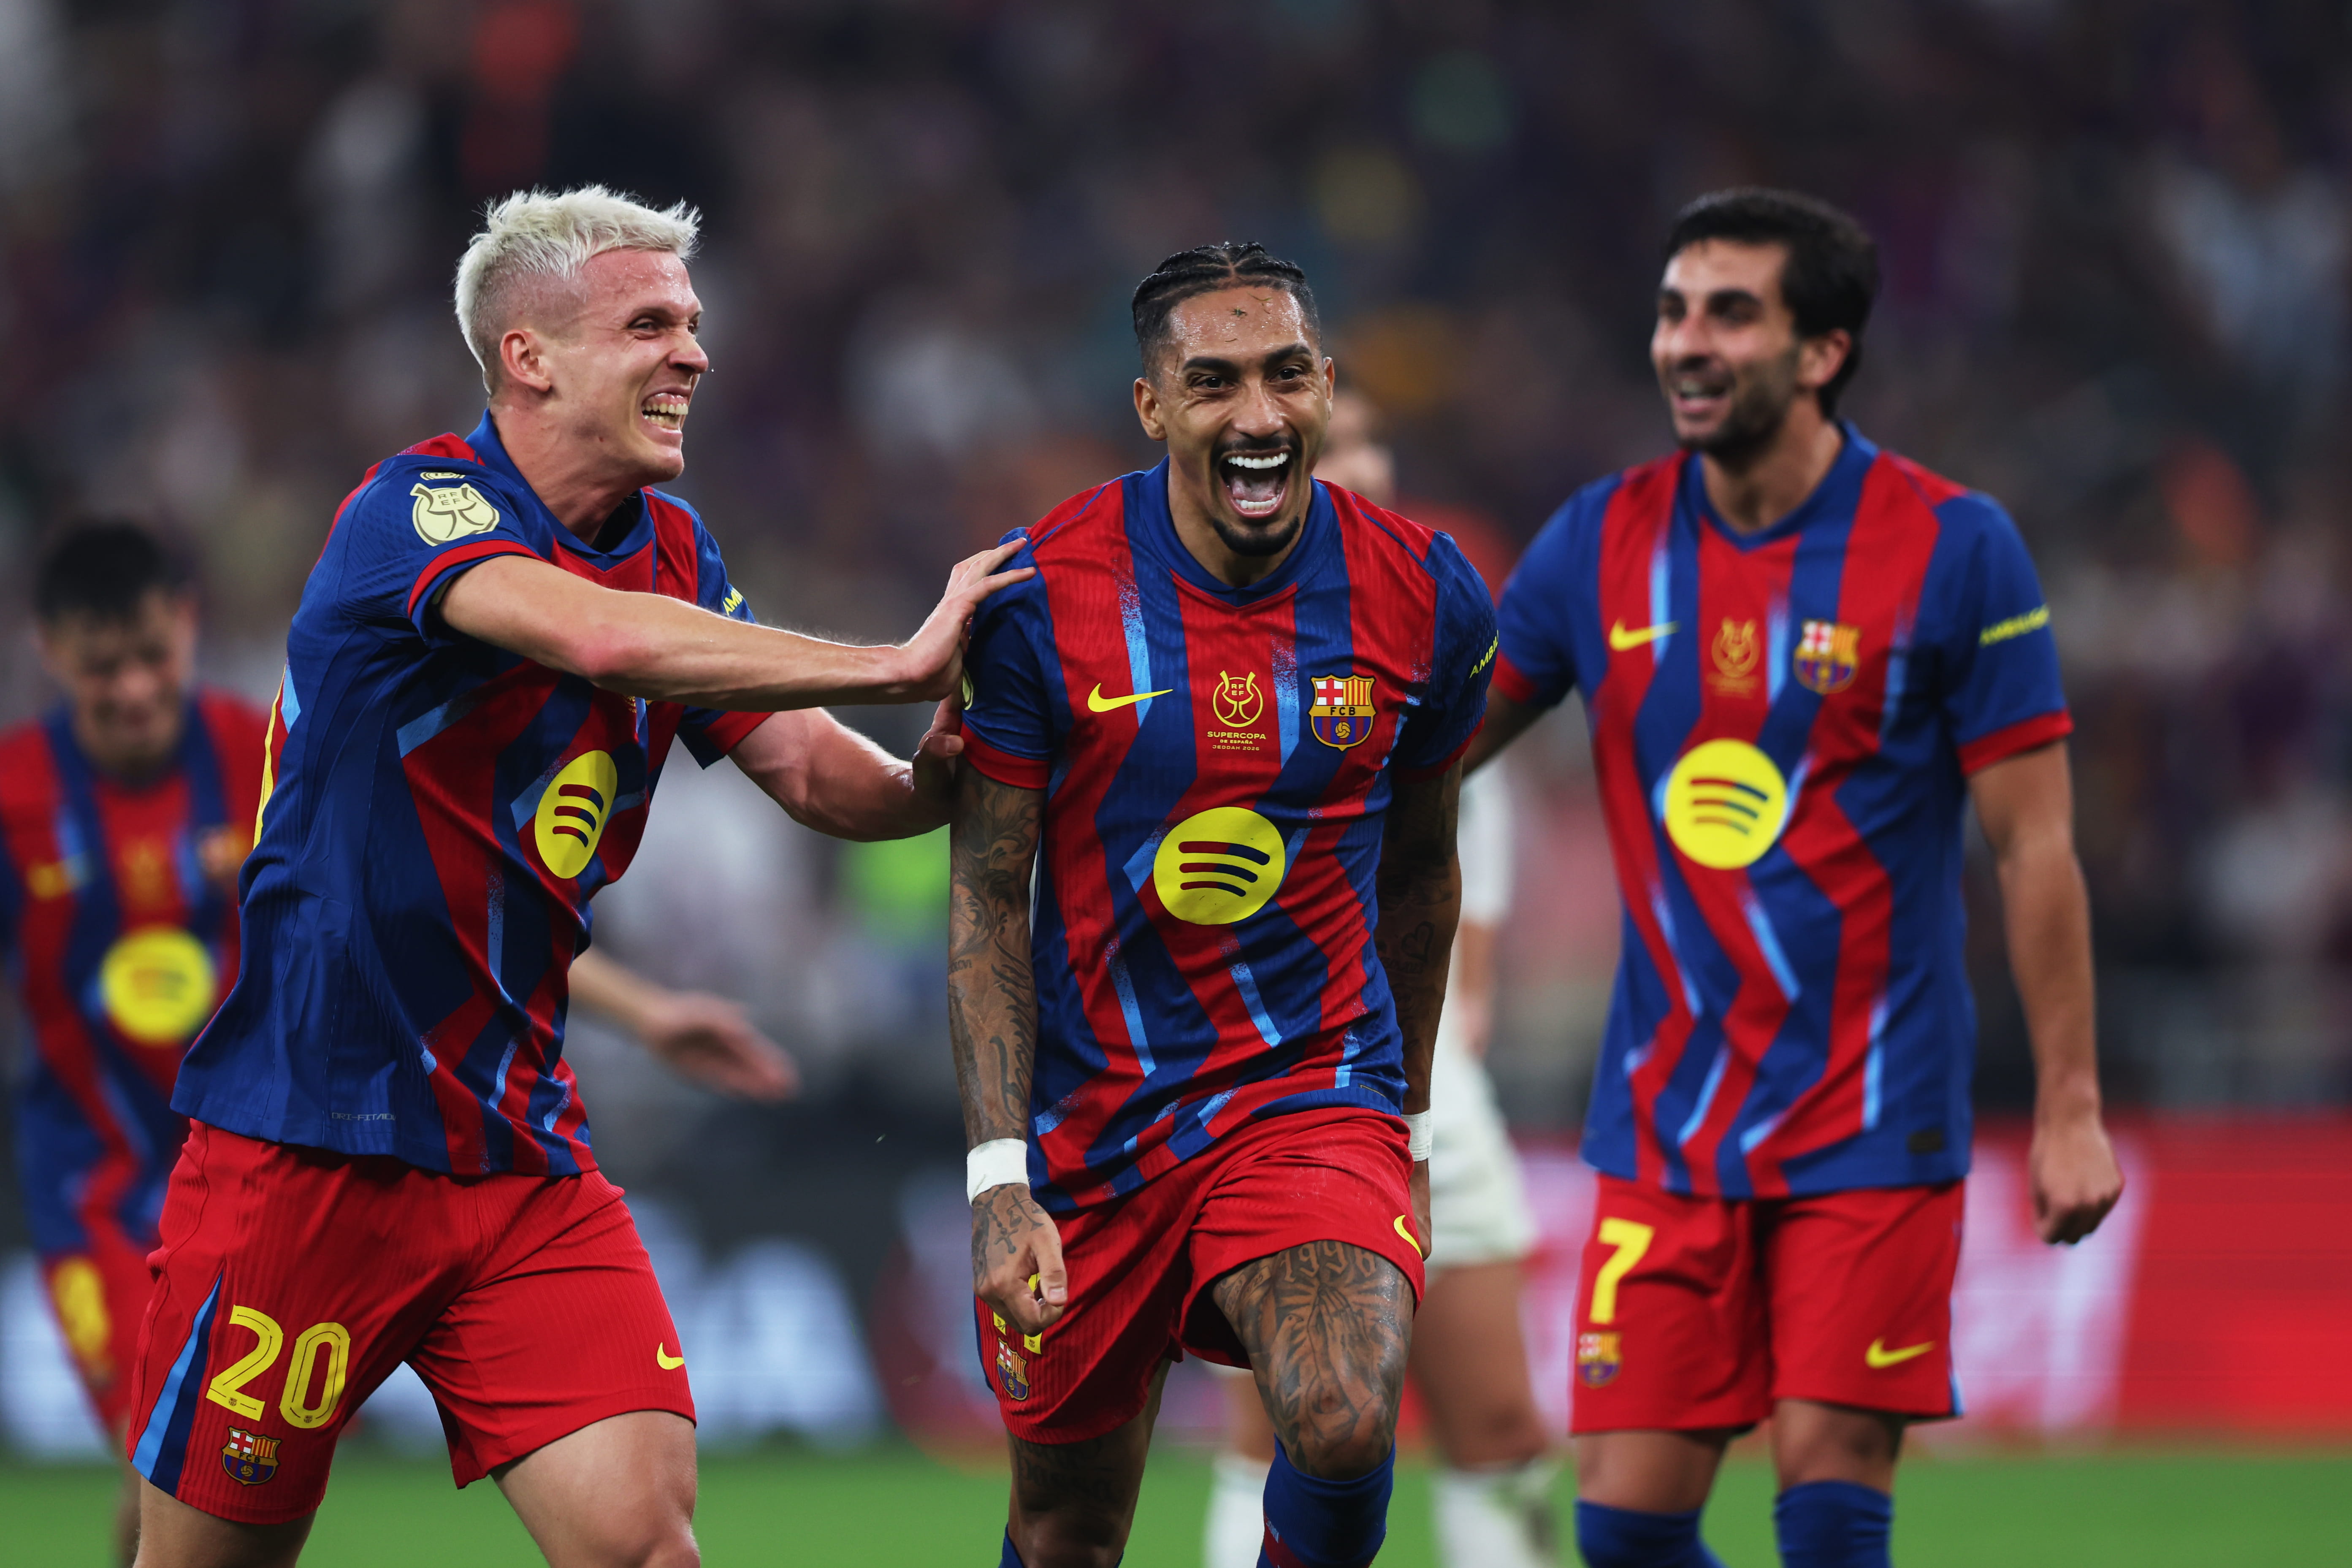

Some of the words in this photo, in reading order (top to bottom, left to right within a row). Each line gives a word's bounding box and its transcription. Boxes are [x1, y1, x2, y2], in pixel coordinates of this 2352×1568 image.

[1330, 707, 1356, 716] FCB
[1207, 731, 1266, 739] SUPERCOPA
[1589, 1216, 1656, 1325] 7
[206, 1304, 351, 1429] 20
[238, 1452, 260, 1463] FCB
